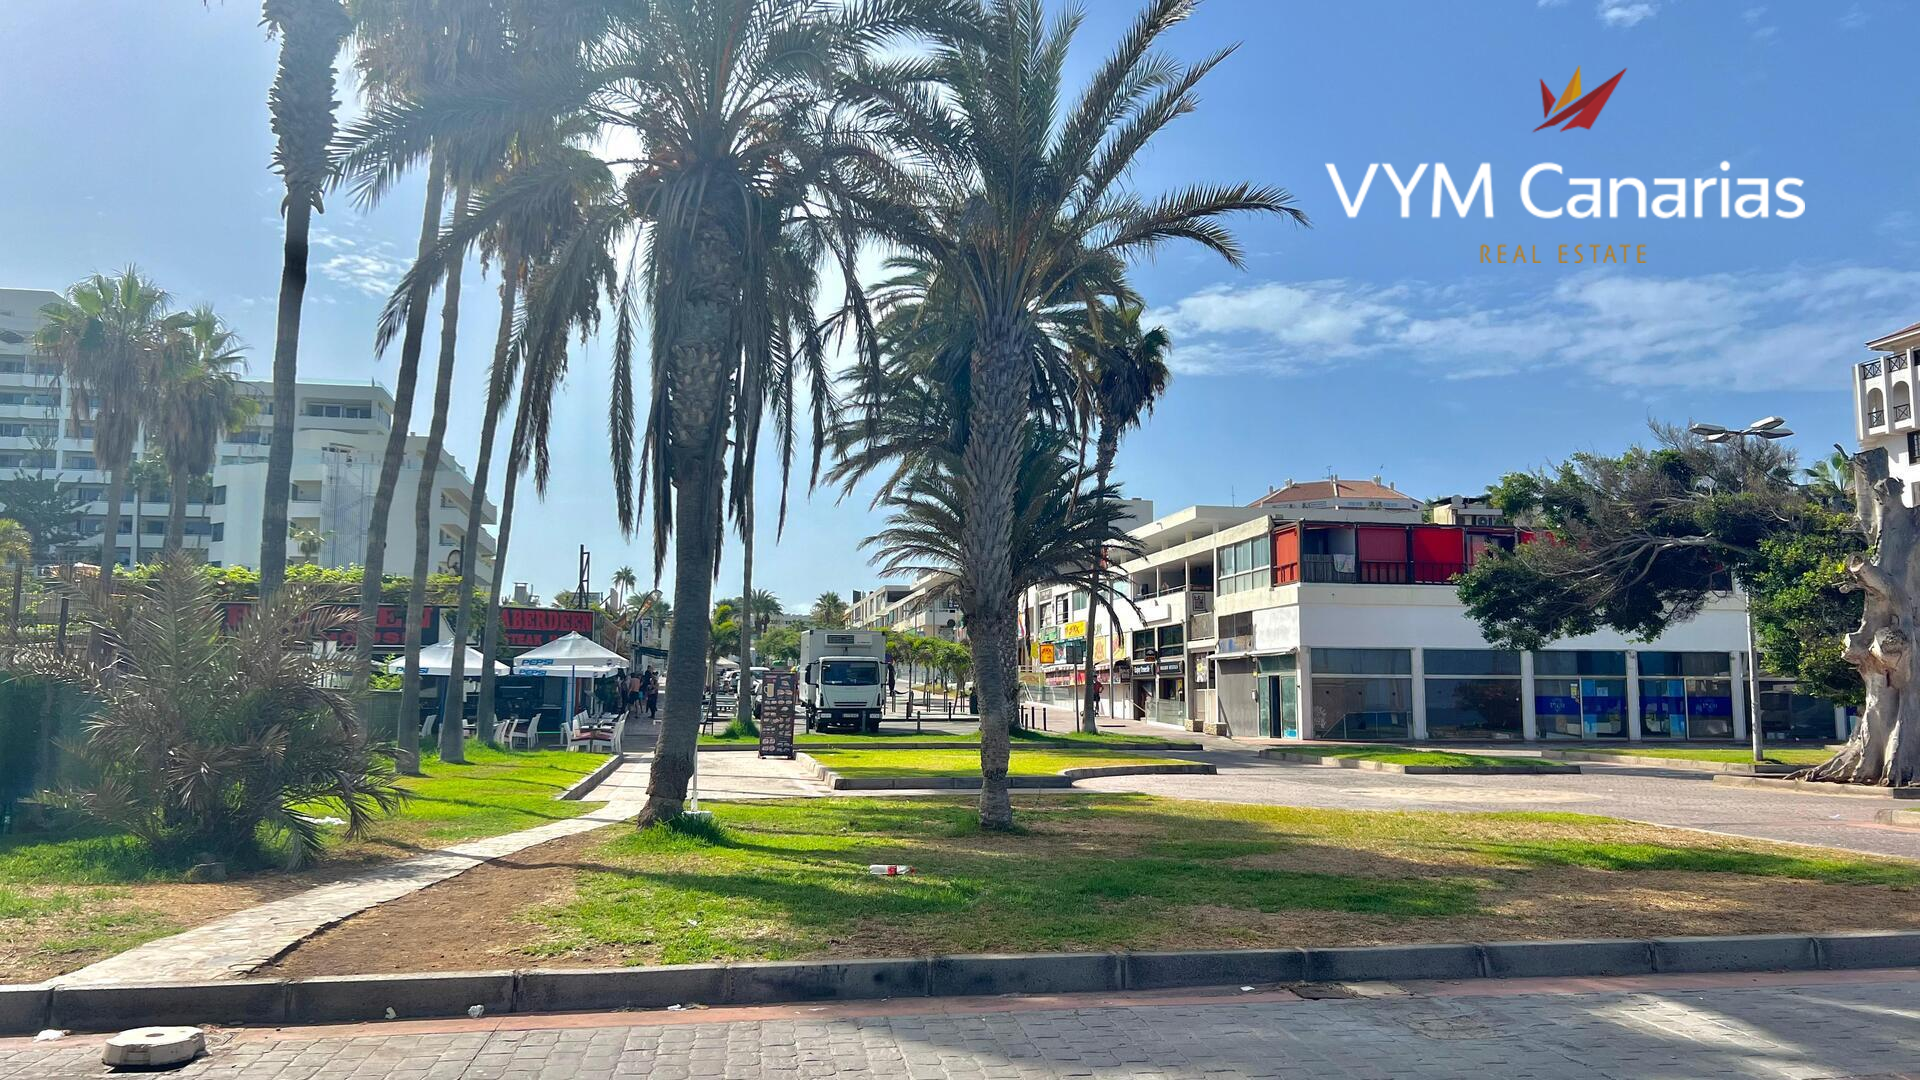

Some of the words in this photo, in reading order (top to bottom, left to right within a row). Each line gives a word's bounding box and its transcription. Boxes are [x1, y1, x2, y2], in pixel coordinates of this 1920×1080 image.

[501, 608, 593, 632] ABERDEEN
[522, 658, 553, 666] PEPSI
[395, 666, 429, 674] PSI
